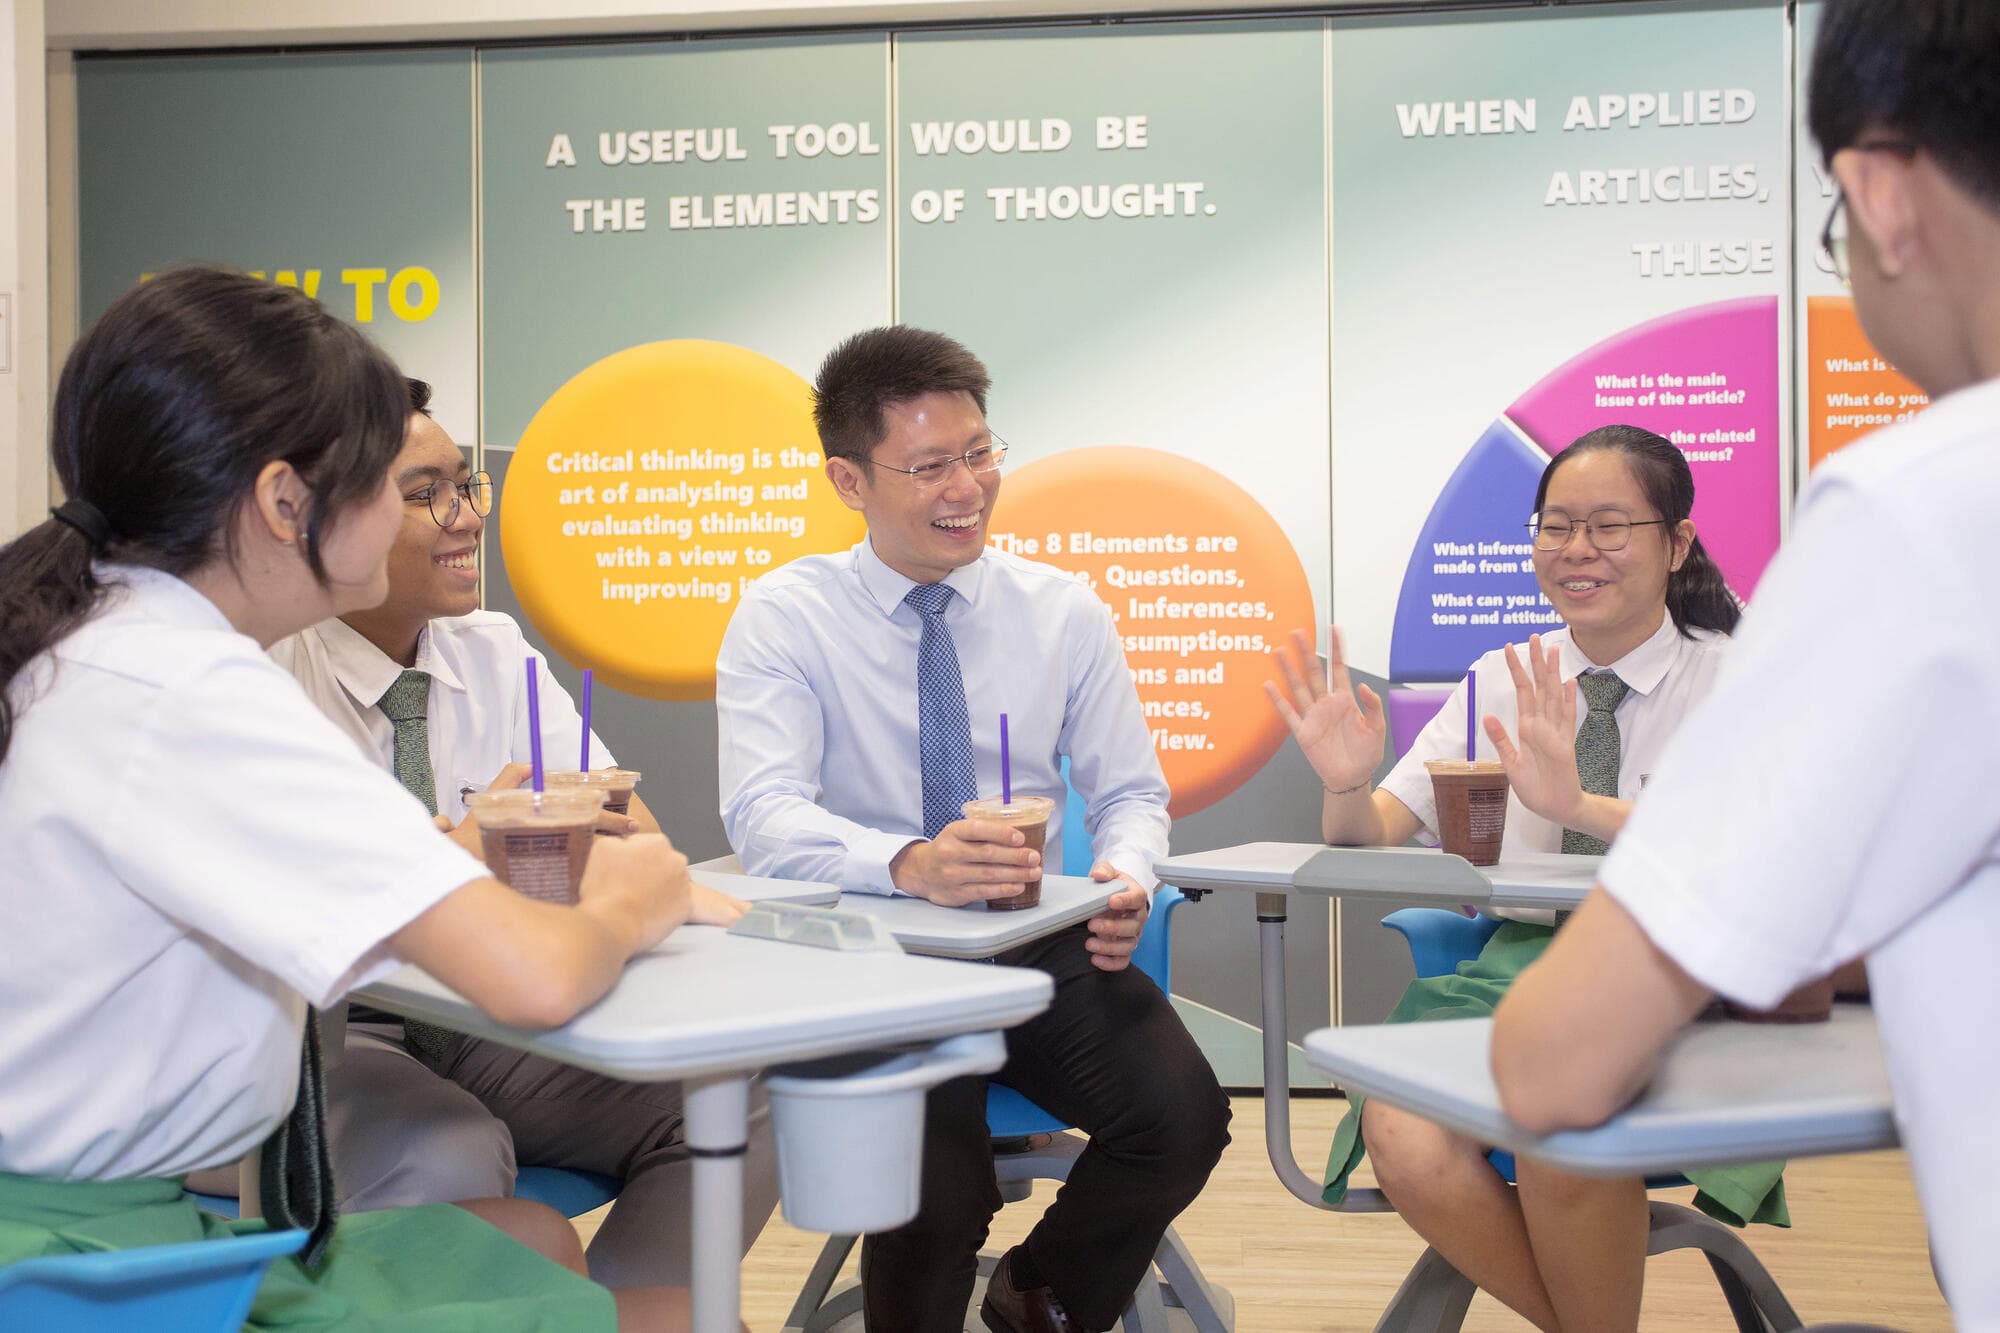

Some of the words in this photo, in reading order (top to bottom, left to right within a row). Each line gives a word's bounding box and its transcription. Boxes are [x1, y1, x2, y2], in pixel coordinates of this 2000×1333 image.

[1395, 98, 1538, 138] WHEN
[1563, 88, 1758, 131] APPLIED
[545, 133, 577, 167] A
[598, 127, 748, 165] USEFUL
[767, 121, 881, 158] TOOL
[910, 117, 1072, 155] WOULD
[1096, 115, 1149, 150] BE
[1543, 164, 1770, 206] ARTICLES,
[565, 197, 647, 233] THE
[668, 189, 881, 230] ELEMENTS
[910, 188, 965, 224] OF
[986, 182, 1217, 221] THOUGHT.
[1632, 240, 1775, 277] THESE
[341, 266, 441, 322] TO
[1825, 358, 1870, 373] What
[1872, 357, 1887, 372] is
[1594, 373, 1636, 390] What
[1640, 373, 1654, 388] is
[1656, 373, 1684, 388] the
[1686, 372, 1727, 387] main
[1594, 392, 1635, 407] issue
[1638, 391, 1656, 406] of
[1658, 391, 1685, 405] the
[1688, 389, 1746, 405] article?
[1826, 393, 1871, 408] What
[1873, 391, 1895, 406] do
[1898, 394, 1929, 409] you
[1826, 413, 1892, 430] purpose
[1669, 429, 1697, 444] the
[1699, 427, 1756, 443] related
[546, 449, 633, 474] Critical
[640, 449, 745, 475] thinking
[752, 448, 773, 469] is
[779, 447, 821, 468] the
[559, 485, 595, 505] art
[601, 482, 630, 503] of
[635, 479, 754, 508] analysing
[761, 478, 808, 500] and
[562, 514, 692, 540] evaluating
[700, 511, 806, 538] thinking
[990, 532, 1039, 554] The
[1046, 532, 1062, 554] 8
[1069, 531, 1189, 554] Elements
[1195, 535, 1238, 552] are
[1433, 541, 1476, 556] What
[1478, 540, 1535, 556] inferen
[596, 545, 651, 568] with
[657, 551, 673, 567] a
[679, 544, 737, 566] view
[745, 545, 772, 565] to
[1433, 559, 1476, 574] made
[1479, 558, 1518, 574] from
[1521, 559, 1537, 573] th
[1105, 564, 1245, 588] Questions,
[602, 576, 732, 605] improving
[1431, 592, 1474, 607] What
[1476, 594, 1503, 607] can
[1506, 594, 1536, 610] you
[1128, 596, 1275, 621] Inferences,
[1431, 612, 1467, 625] tone
[1470, 610, 1500, 625] and
[1120, 629, 1272, 657] sumptions,
[1174, 661, 1224, 685] and
